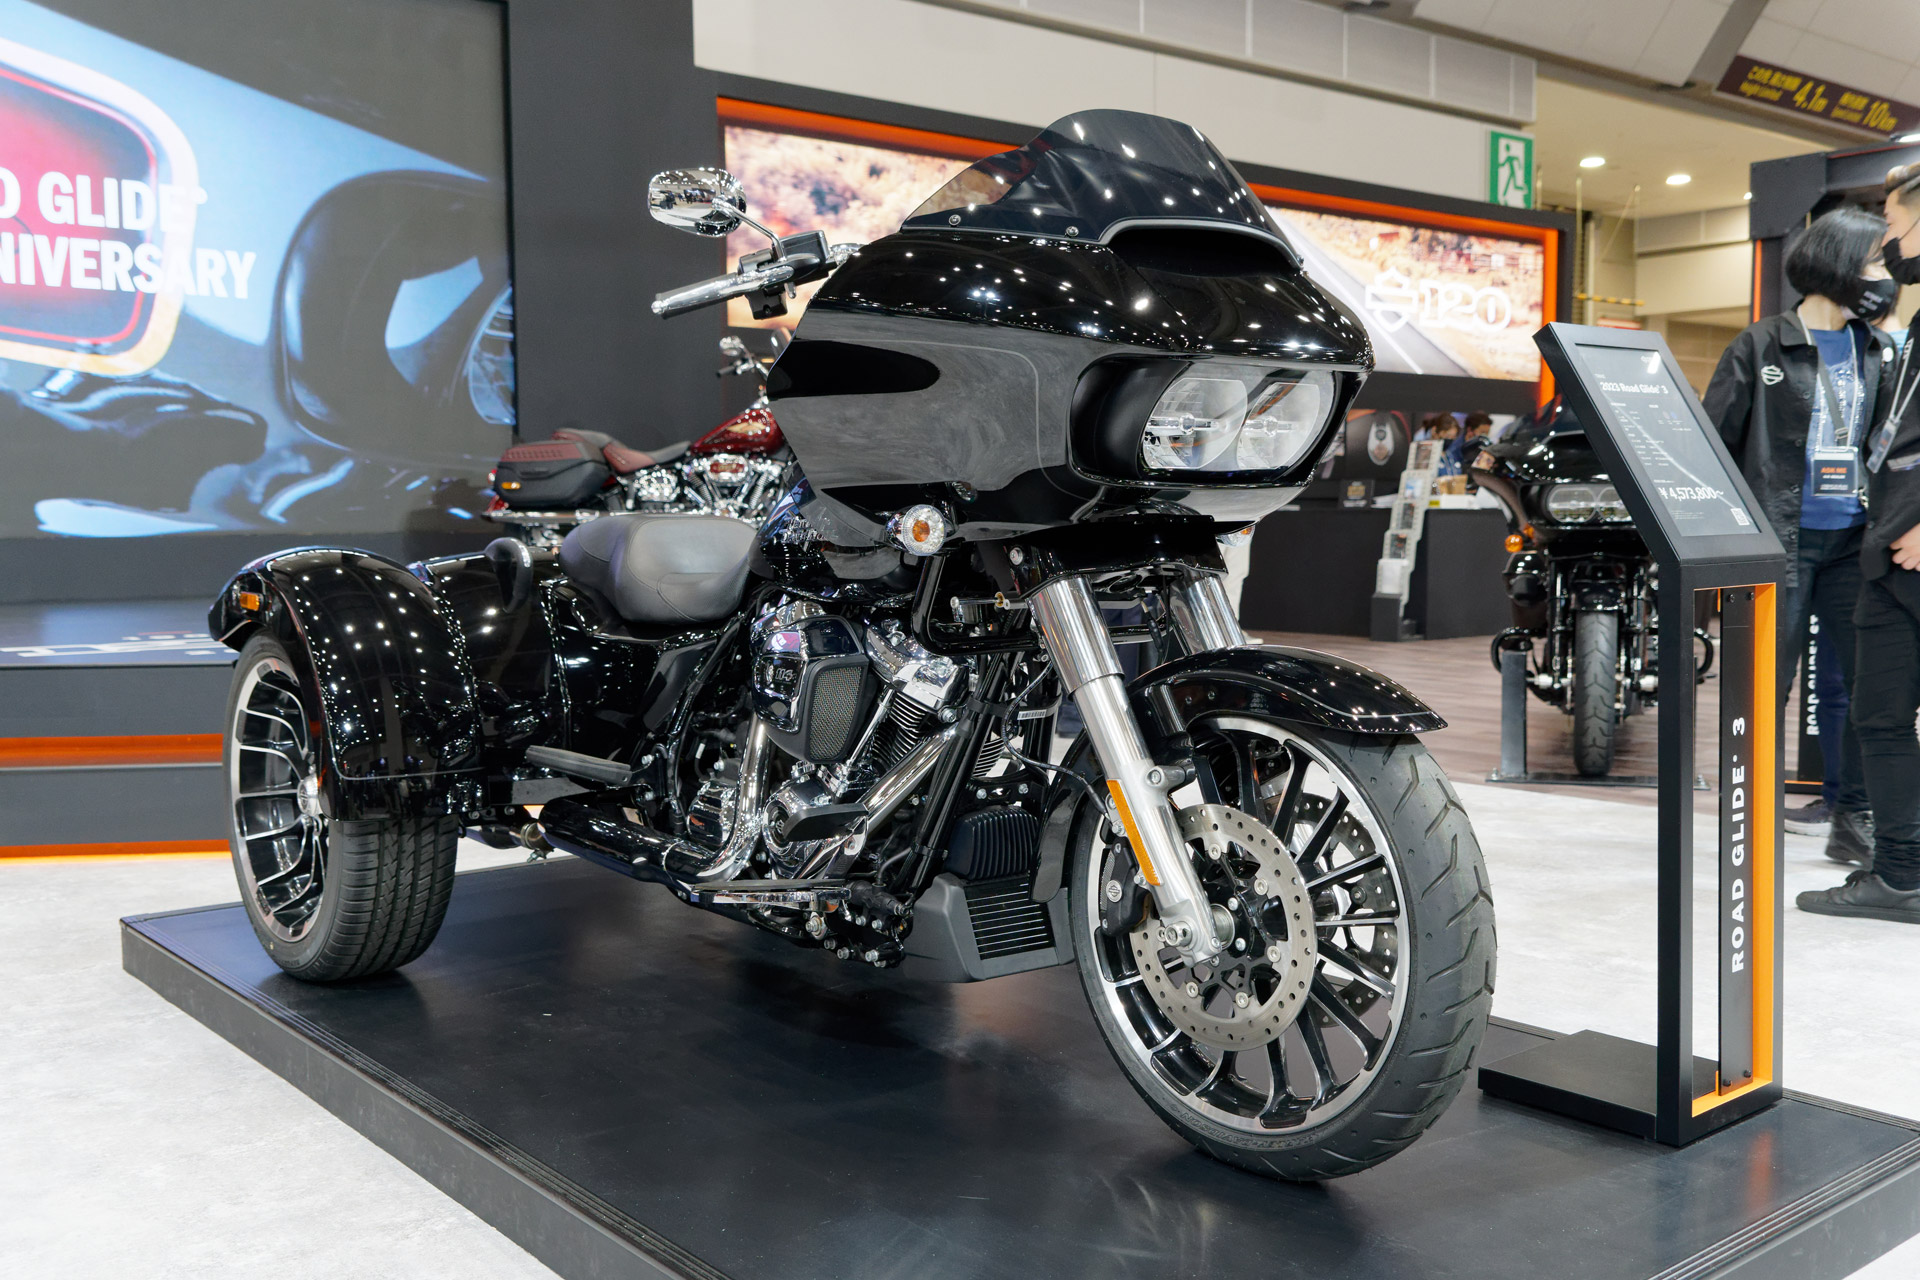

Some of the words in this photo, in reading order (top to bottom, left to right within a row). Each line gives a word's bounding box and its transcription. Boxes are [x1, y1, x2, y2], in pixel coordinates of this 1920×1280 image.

[1419, 278, 1512, 333] 120
[1732, 717, 1746, 736] 3
[1731, 878, 1745, 973] ROAD
